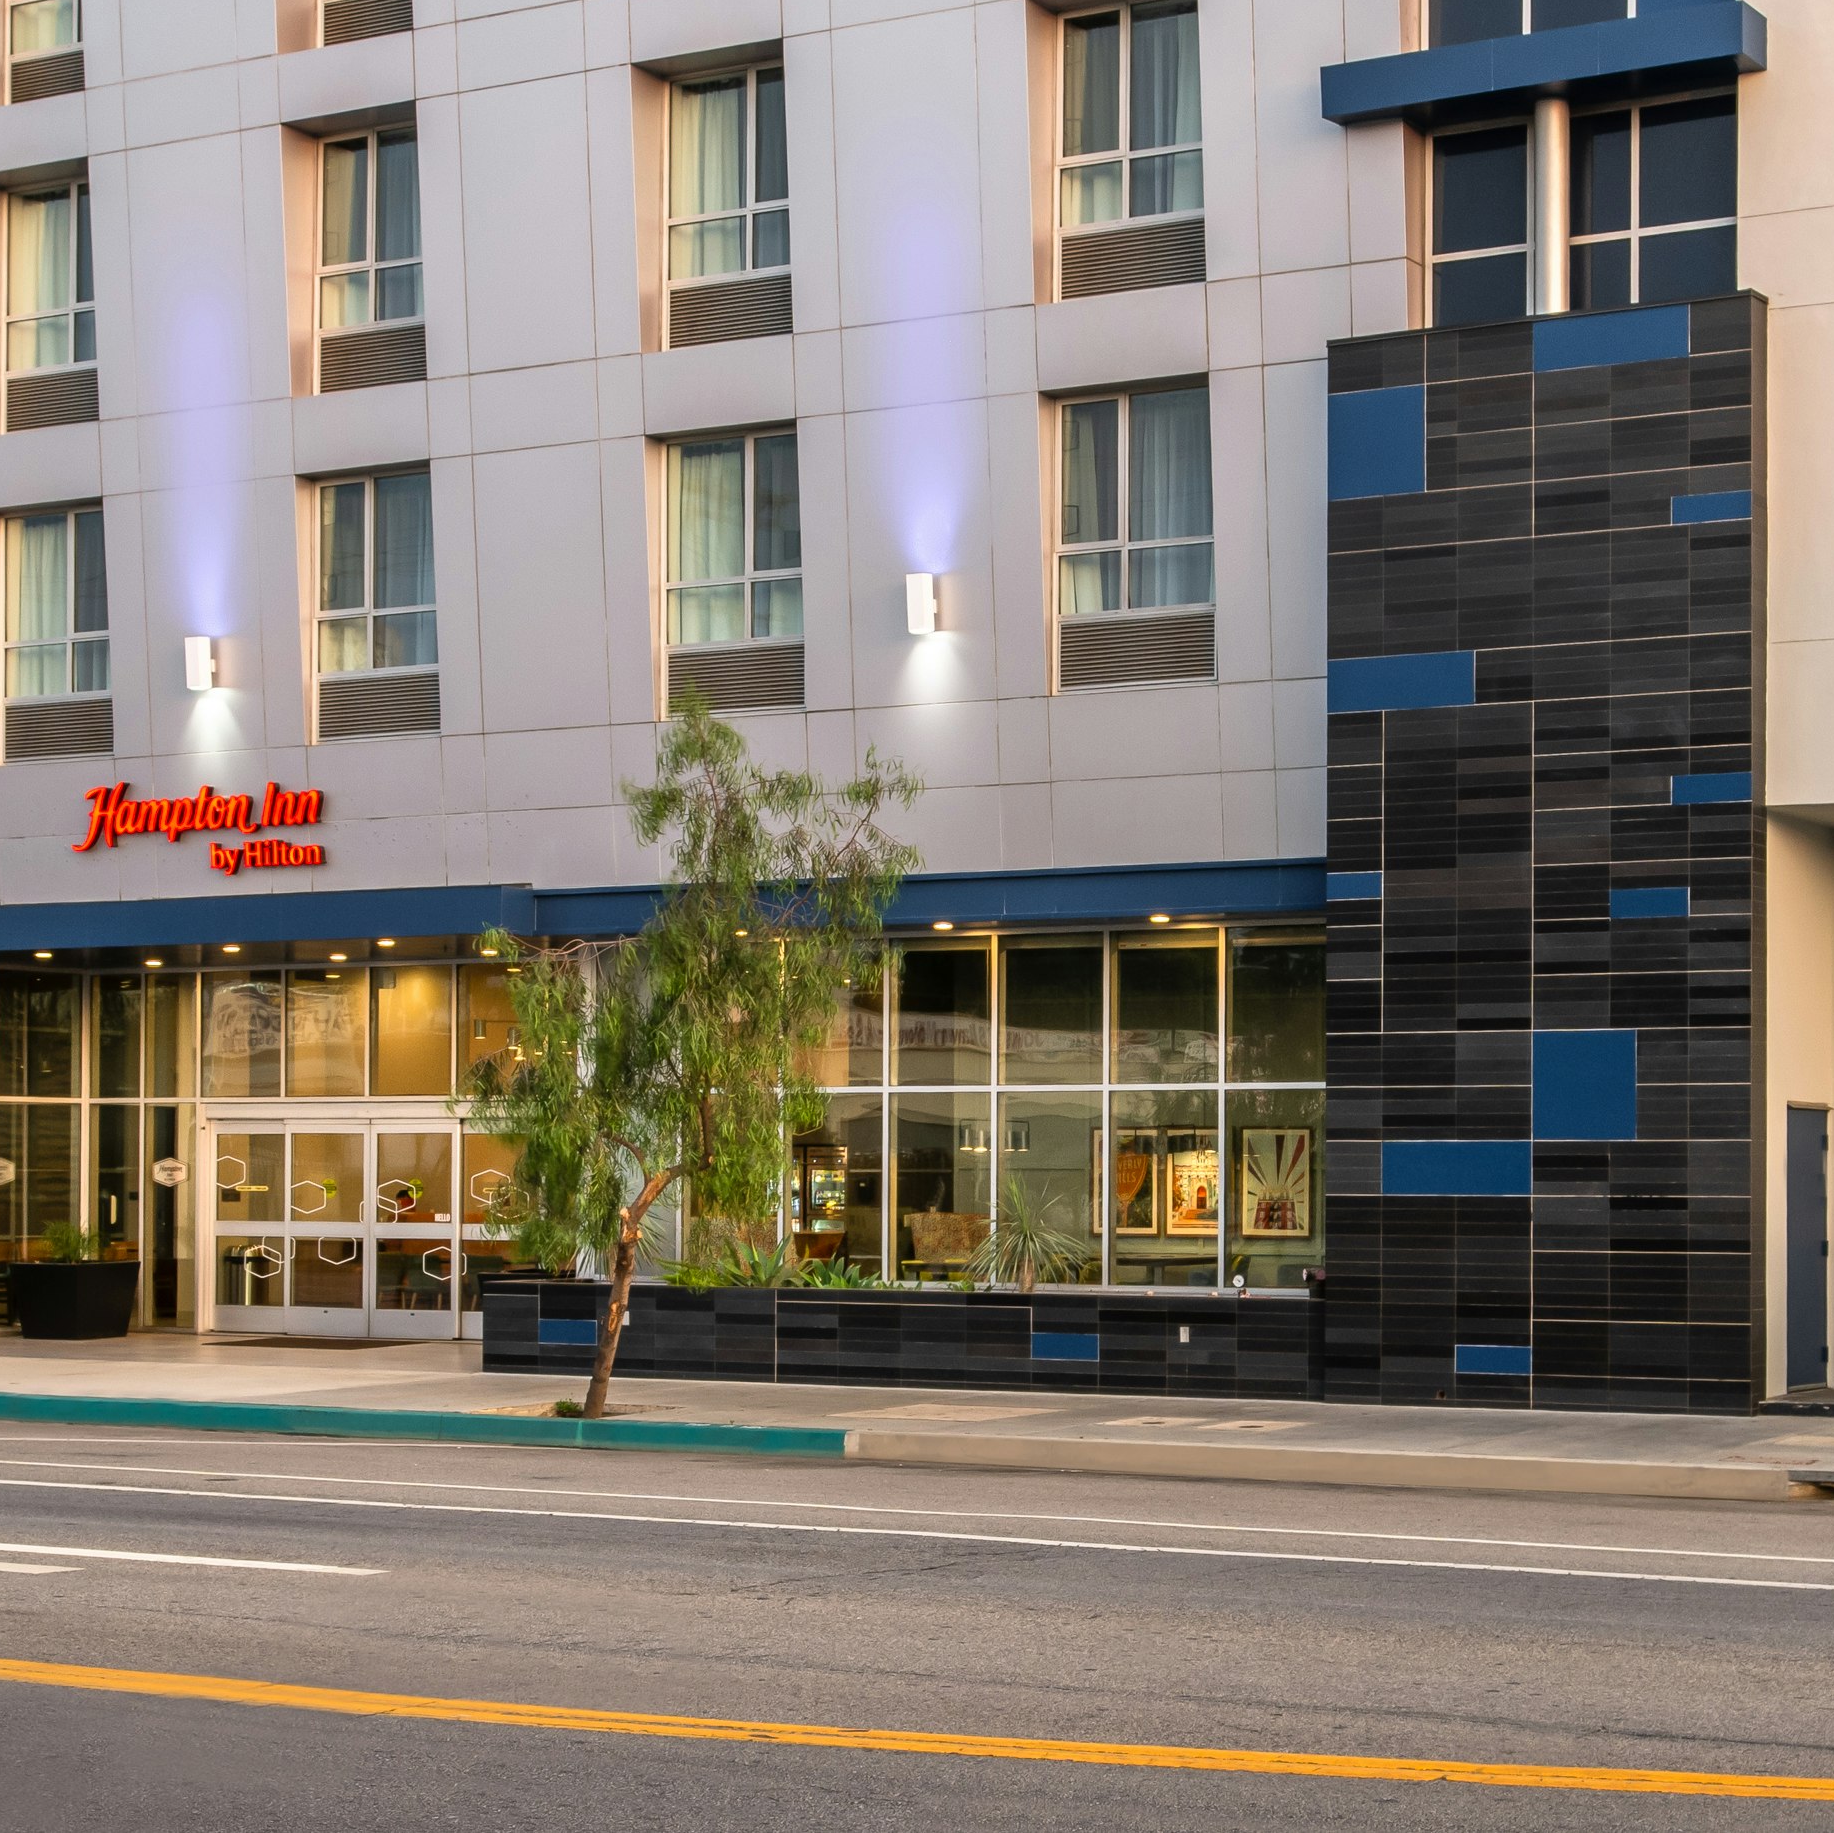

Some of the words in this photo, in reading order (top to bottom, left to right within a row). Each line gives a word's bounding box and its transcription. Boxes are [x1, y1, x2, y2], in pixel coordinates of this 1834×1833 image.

[71, 781, 260, 853] Hampton
[261, 781, 322, 827] Inn
[210, 842, 240, 876] by
[243, 839, 323, 867] Hilton
[1118, 1157, 1142, 1170] VERLY
